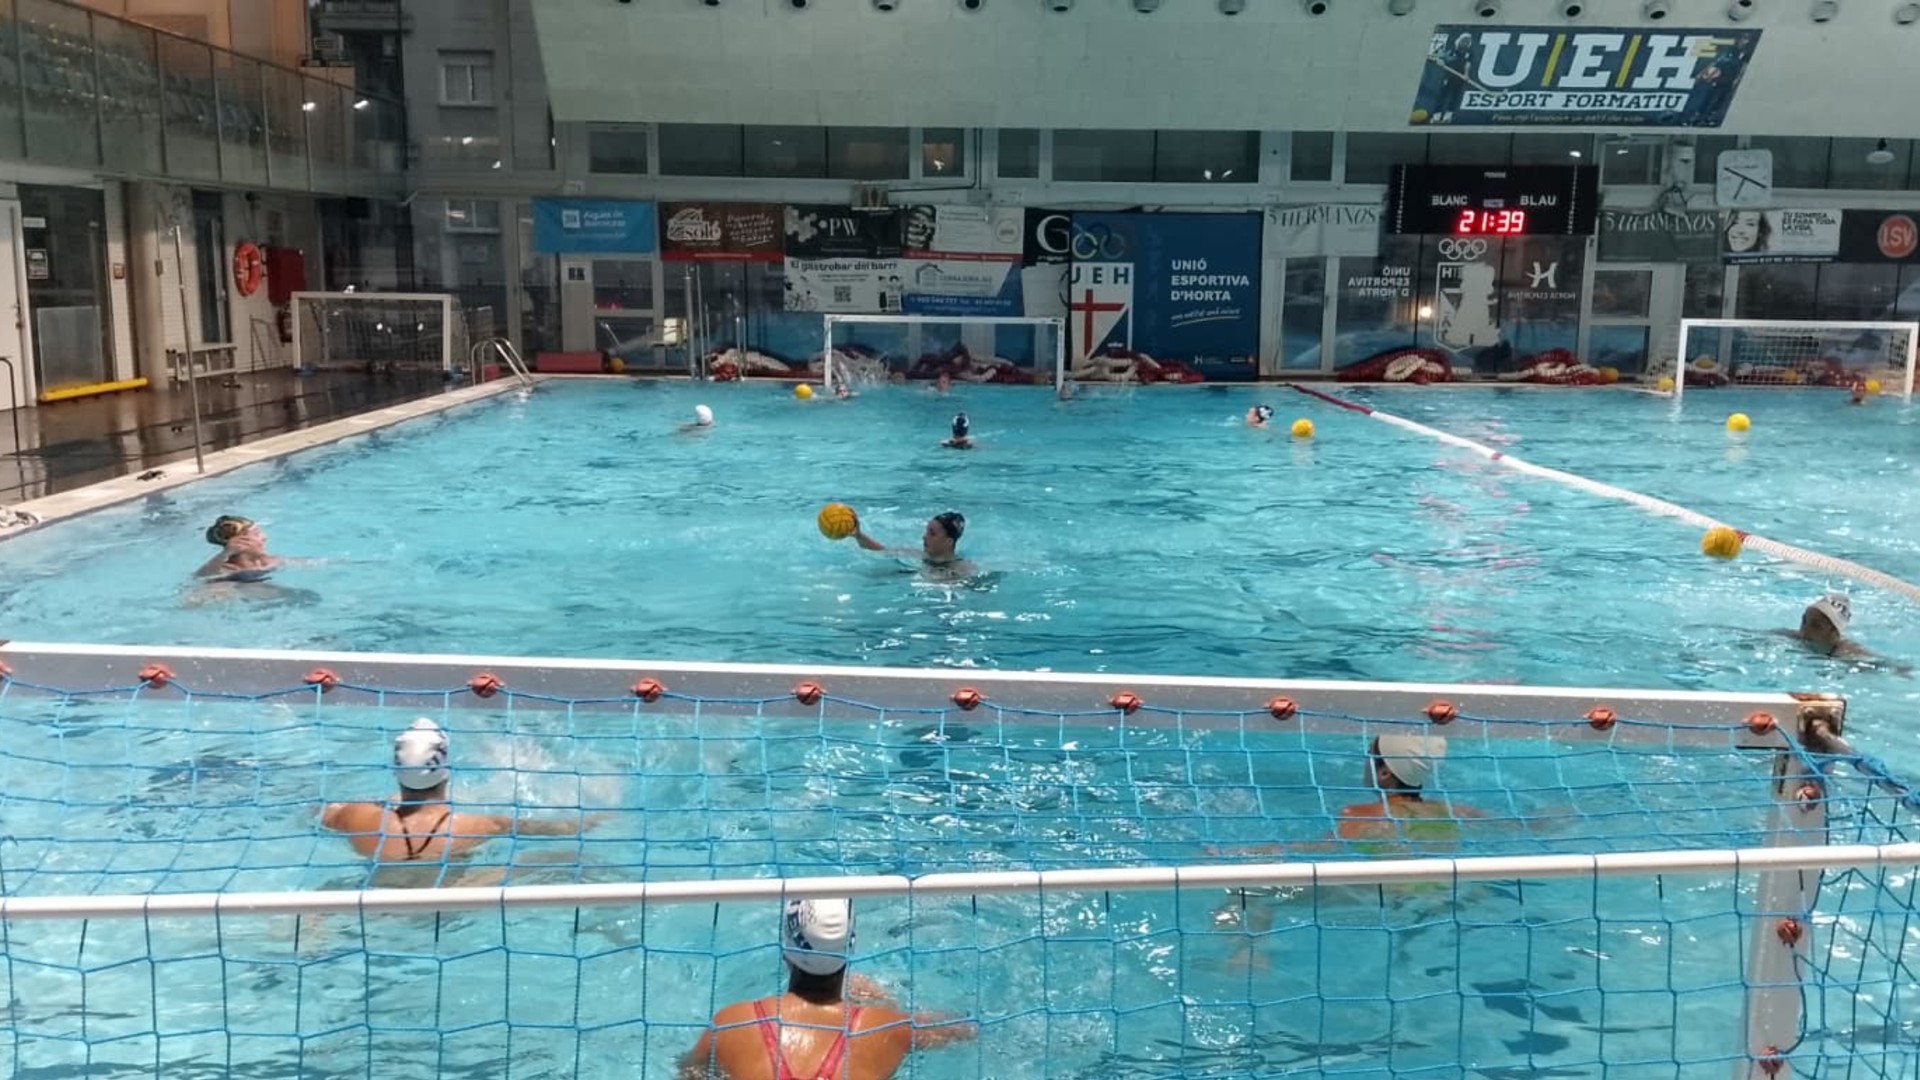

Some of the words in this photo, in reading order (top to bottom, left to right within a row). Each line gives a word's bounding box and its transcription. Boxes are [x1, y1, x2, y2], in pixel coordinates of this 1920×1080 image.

[1465, 93, 1554, 109] ESPORT
[1564, 93, 1683, 110] FORMATIU
[1431, 195, 1468, 206] BLANC
[1520, 195, 1556, 206] BLAU
[1459, 210, 1525, 232] 21:39
[801, 261, 852, 273] gastrobar
[1171, 257, 1207, 271] UNIÓ
[1171, 275, 1250, 286] ESPORTIVA
[1171, 290, 1232, 301] D'HORTA
